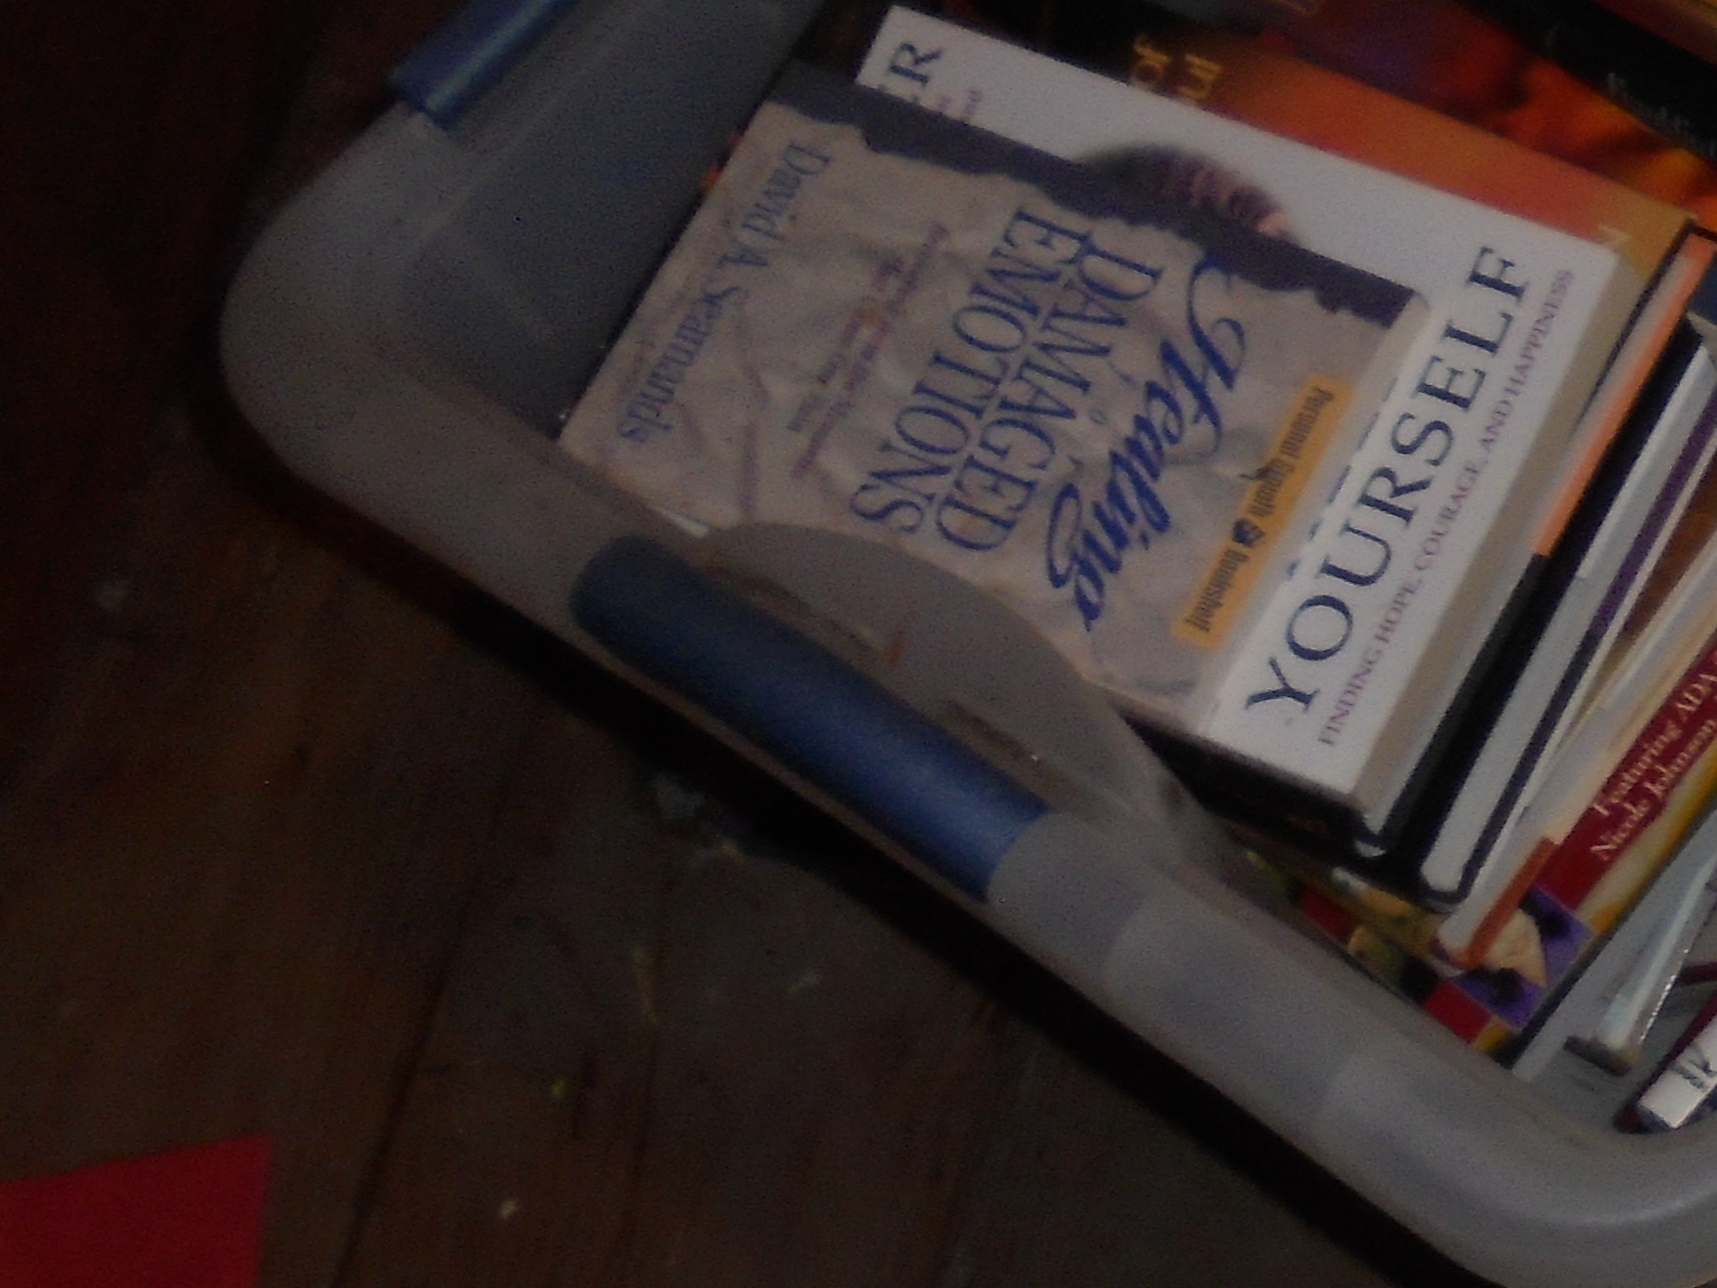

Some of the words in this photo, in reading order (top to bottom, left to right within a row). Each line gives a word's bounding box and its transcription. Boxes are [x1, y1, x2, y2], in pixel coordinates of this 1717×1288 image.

[742, 141, 832, 241] David
[618, 286, 744, 445] Seamands
[850, 209, 1093, 534] EMOTIONS
[936, 245, 1164, 551] DAMAGED
[1046, 255, 1246, 633] Healing
[1281, 387, 1335, 459] Personal
[1246, 246, 1530, 712] YOURSELF
[1317, 648, 1381, 747] FINDING
[1480, 406, 1511, 452] AND
[1503, 270, 1574, 412] HAPPINESS
[1186, 548, 1251, 634] Bookshelf
[1589, 797, 1651, 862] Nicole
[1594, 721, 1683, 817] Featuring
